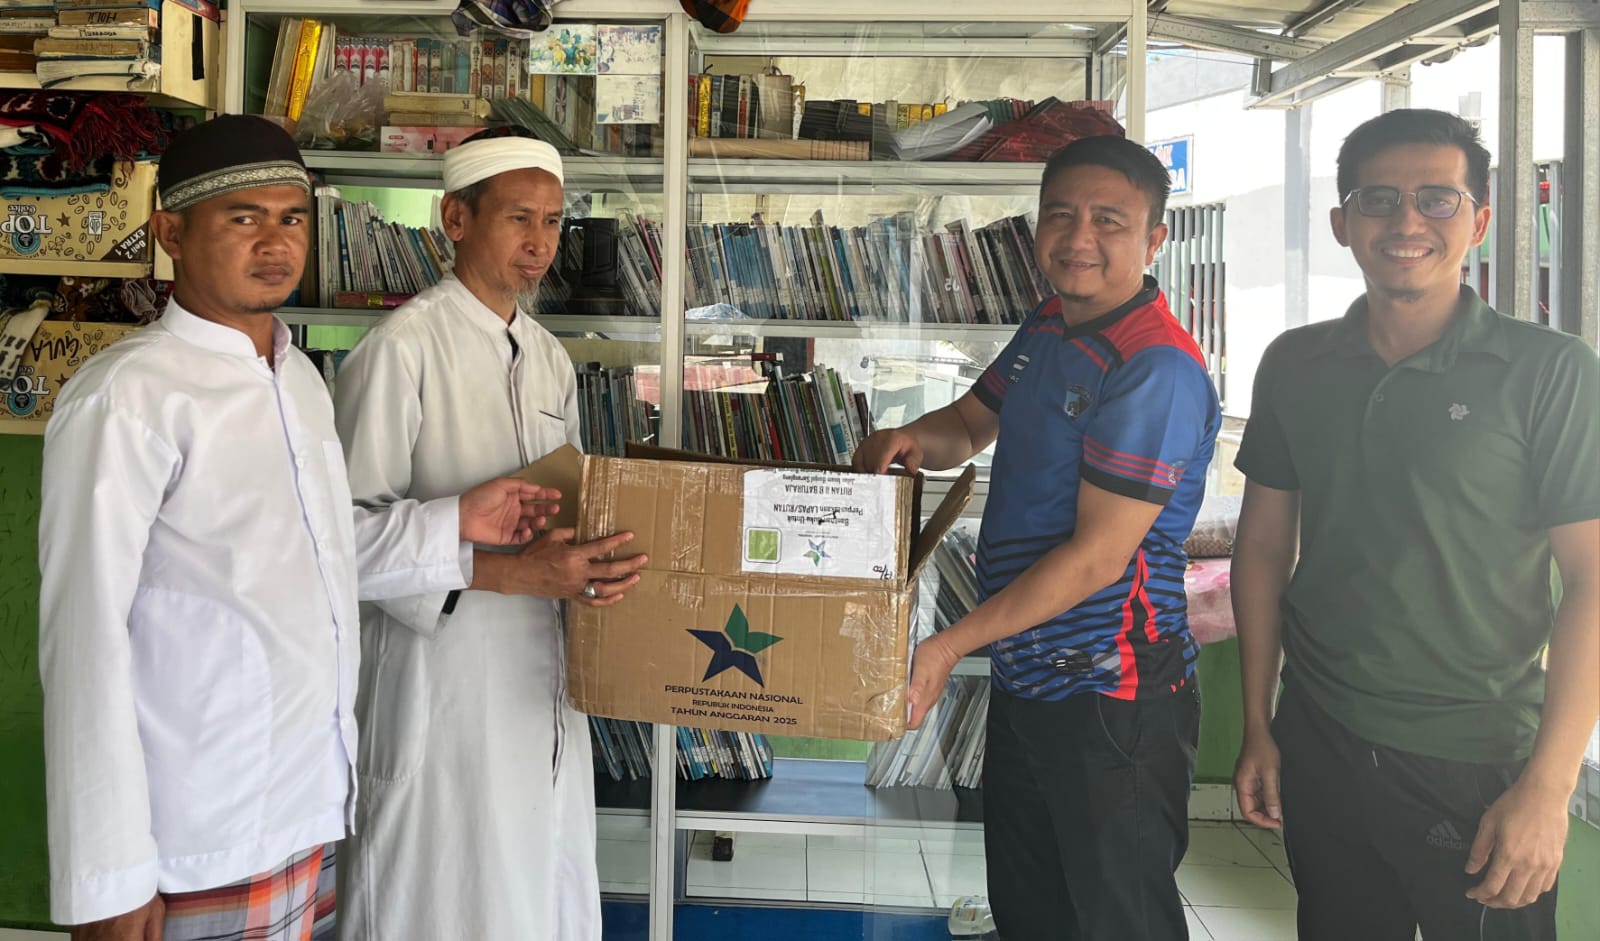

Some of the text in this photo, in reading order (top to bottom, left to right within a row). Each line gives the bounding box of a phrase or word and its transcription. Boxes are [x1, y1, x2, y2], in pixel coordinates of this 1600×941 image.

[0, 215, 52, 234] TOP
[120, 229, 145, 250] EXTRA
[125, 240, 146, 260] Beli 2
[31, 336, 80, 362] GULA
[785, 484, 817, 494] BATURAJA
[832, 486, 853, 496] RUTAN
[773, 503, 818, 513] LAPAS/RUTAN
[787, 515, 805, 524] Untuk
[664, 685, 804, 705] PERPUSTAKAAN NASIONAL
[671, 706, 798, 725] TAHUN ANGGARAN 2025
[692, 699, 774, 713] REPUBLIK INDONESIA
